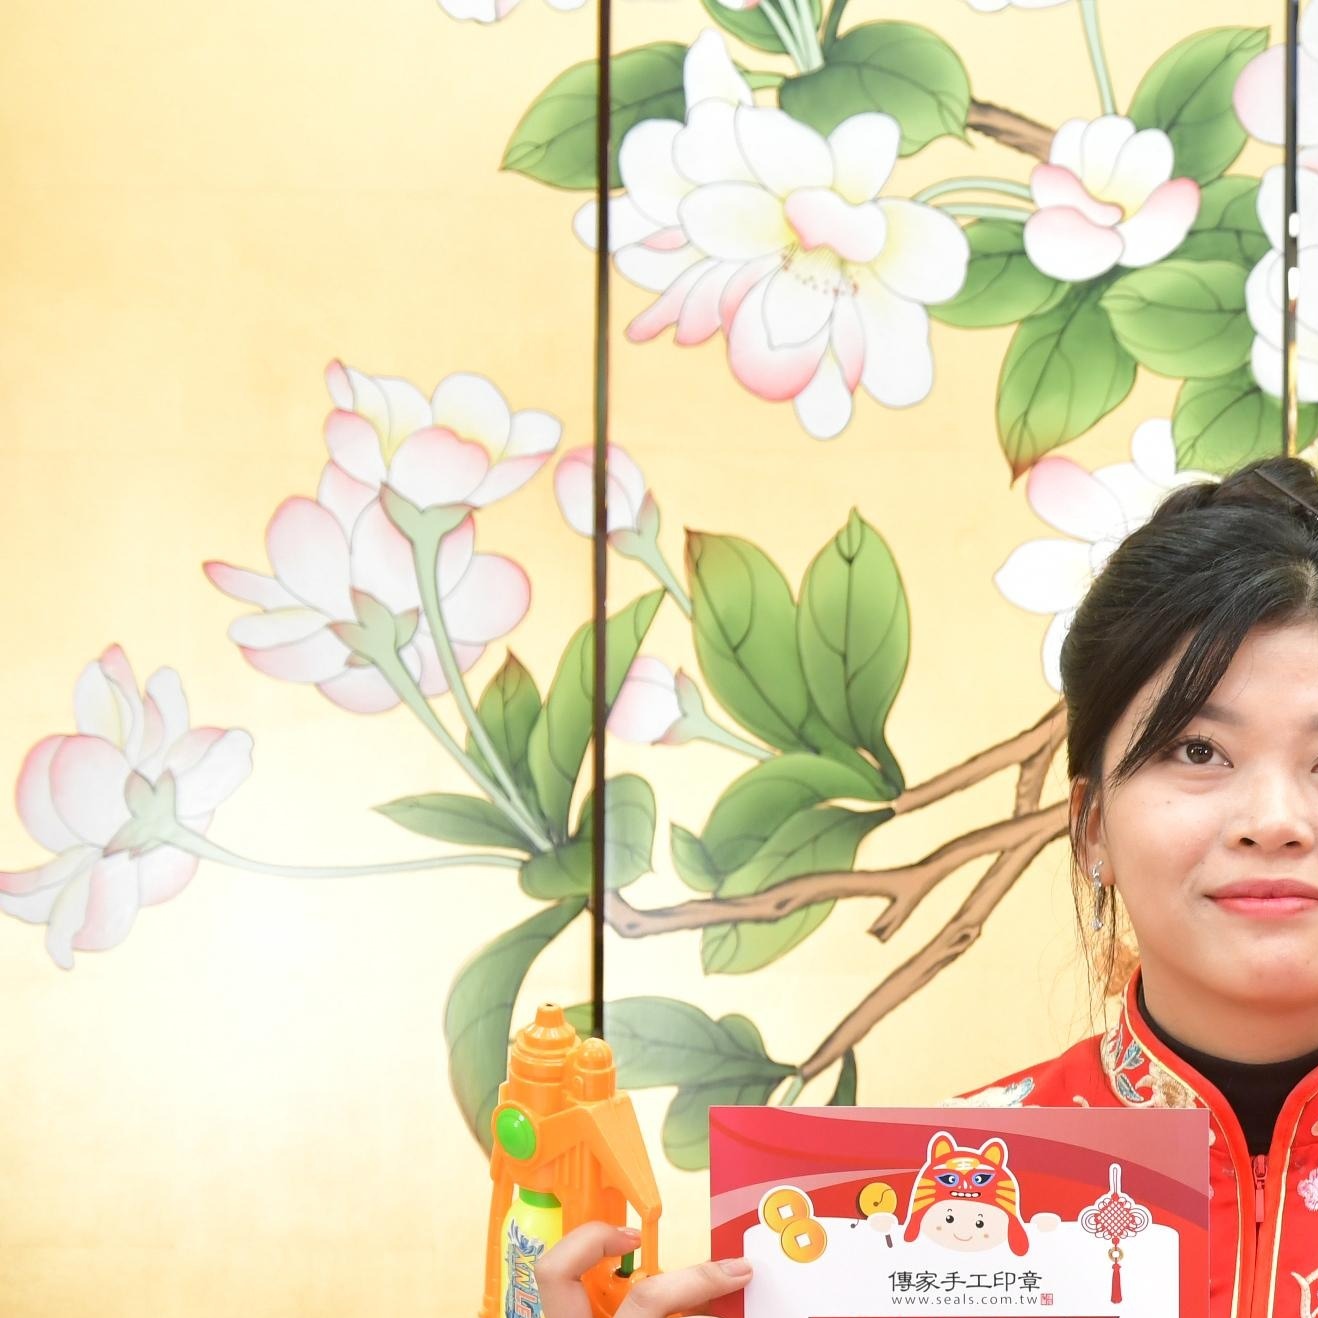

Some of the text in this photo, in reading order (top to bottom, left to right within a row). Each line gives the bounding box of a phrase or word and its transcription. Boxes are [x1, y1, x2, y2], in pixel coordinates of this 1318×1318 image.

[888, 1270, 1043, 1293] 傳家手工印章
[891, 1294, 1038, 1305] www.seals.com.tw
